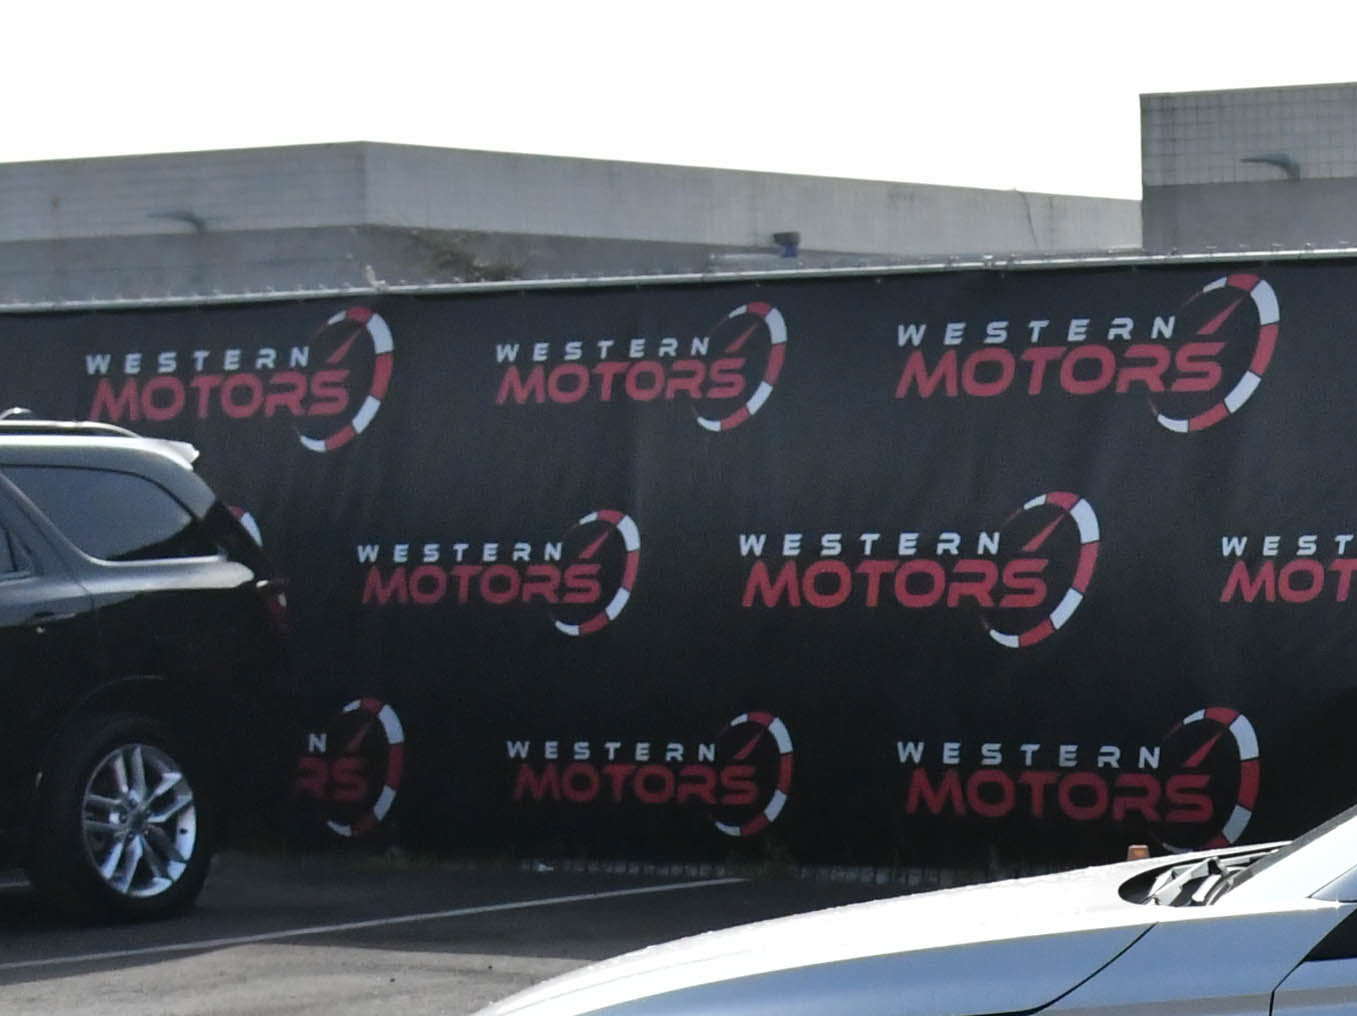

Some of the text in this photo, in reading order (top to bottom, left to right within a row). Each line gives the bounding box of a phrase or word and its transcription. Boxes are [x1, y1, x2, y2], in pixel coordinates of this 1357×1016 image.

[897, 315, 1176, 347] WESTERN
[86, 346, 310, 376] WESTERN
[496, 337, 710, 363] WESTERN
[497, 357, 747, 405] MOTORS
[896, 345, 1226, 399] MOTORS
[90, 367, 349, 422] MOTORS
[357, 542, 564, 563] WESTERN
[739, 531, 1001, 557] WESTERN
[362, 563, 604, 605] MOTORS
[742, 557, 1049, 609] MOTORS
[507, 740, 717, 762] WESTERN
[897, 741, 1160, 770] WESTERN
[515, 763, 760, 805] MOTORS
[906, 768, 1214, 823] MOTORS
